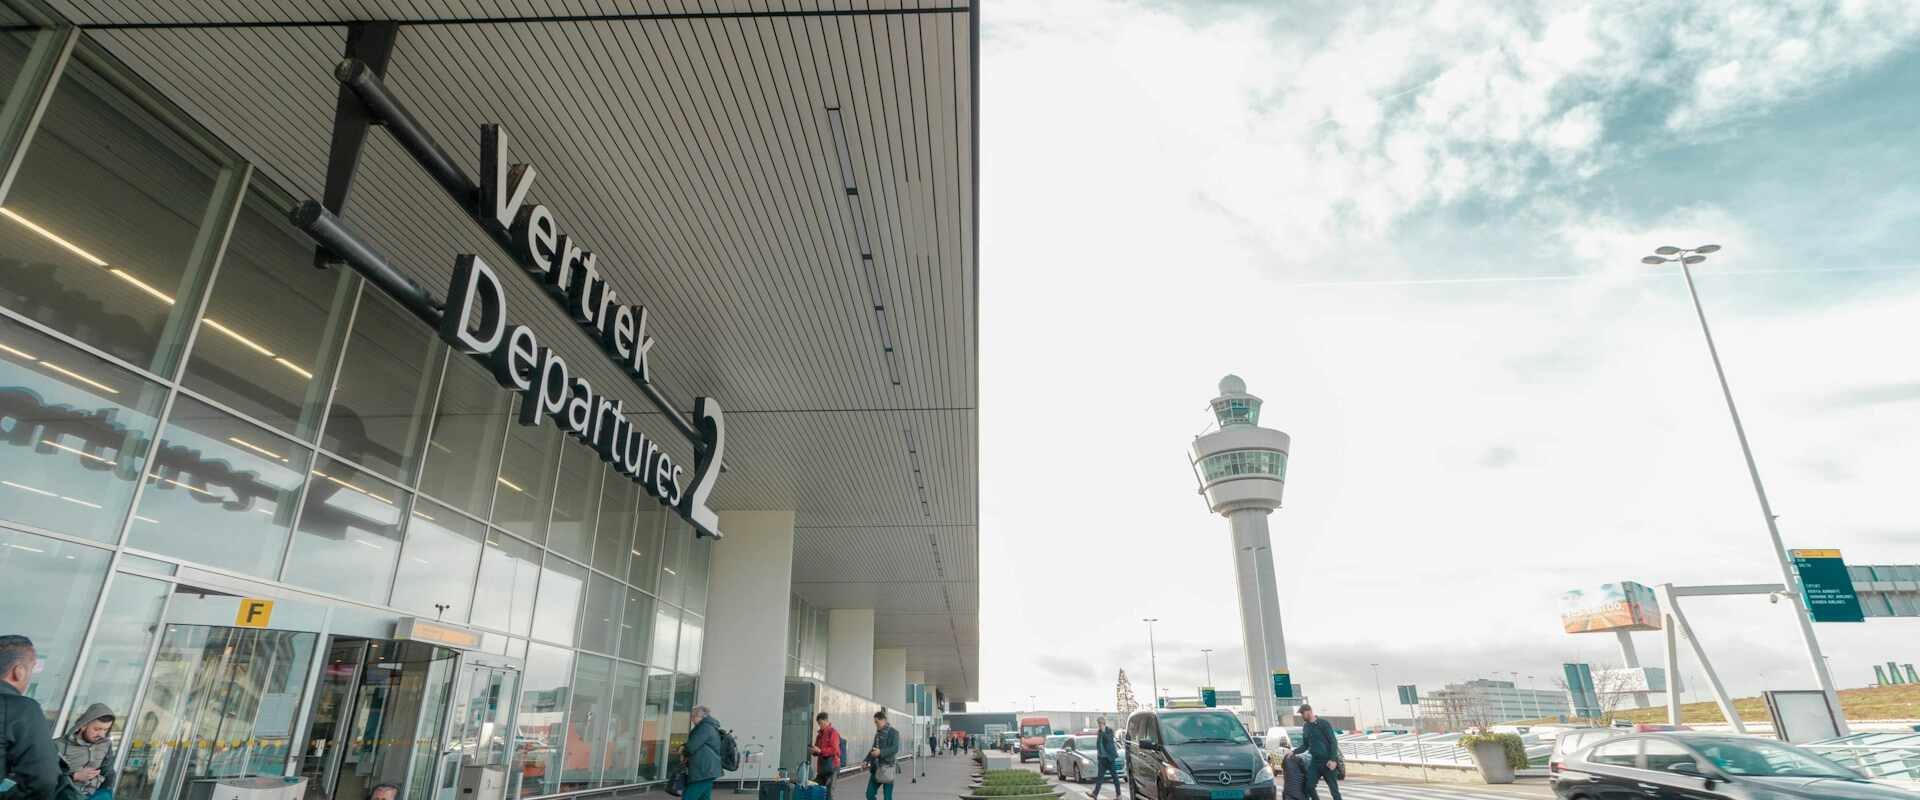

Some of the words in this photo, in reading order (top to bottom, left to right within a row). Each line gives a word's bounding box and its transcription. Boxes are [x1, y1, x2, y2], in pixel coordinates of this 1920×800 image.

[494, 123, 655, 383] Vertrek
[454, 254, 683, 507] Departures
[691, 397, 725, 537] 2
[246, 603, 264, 623] F
